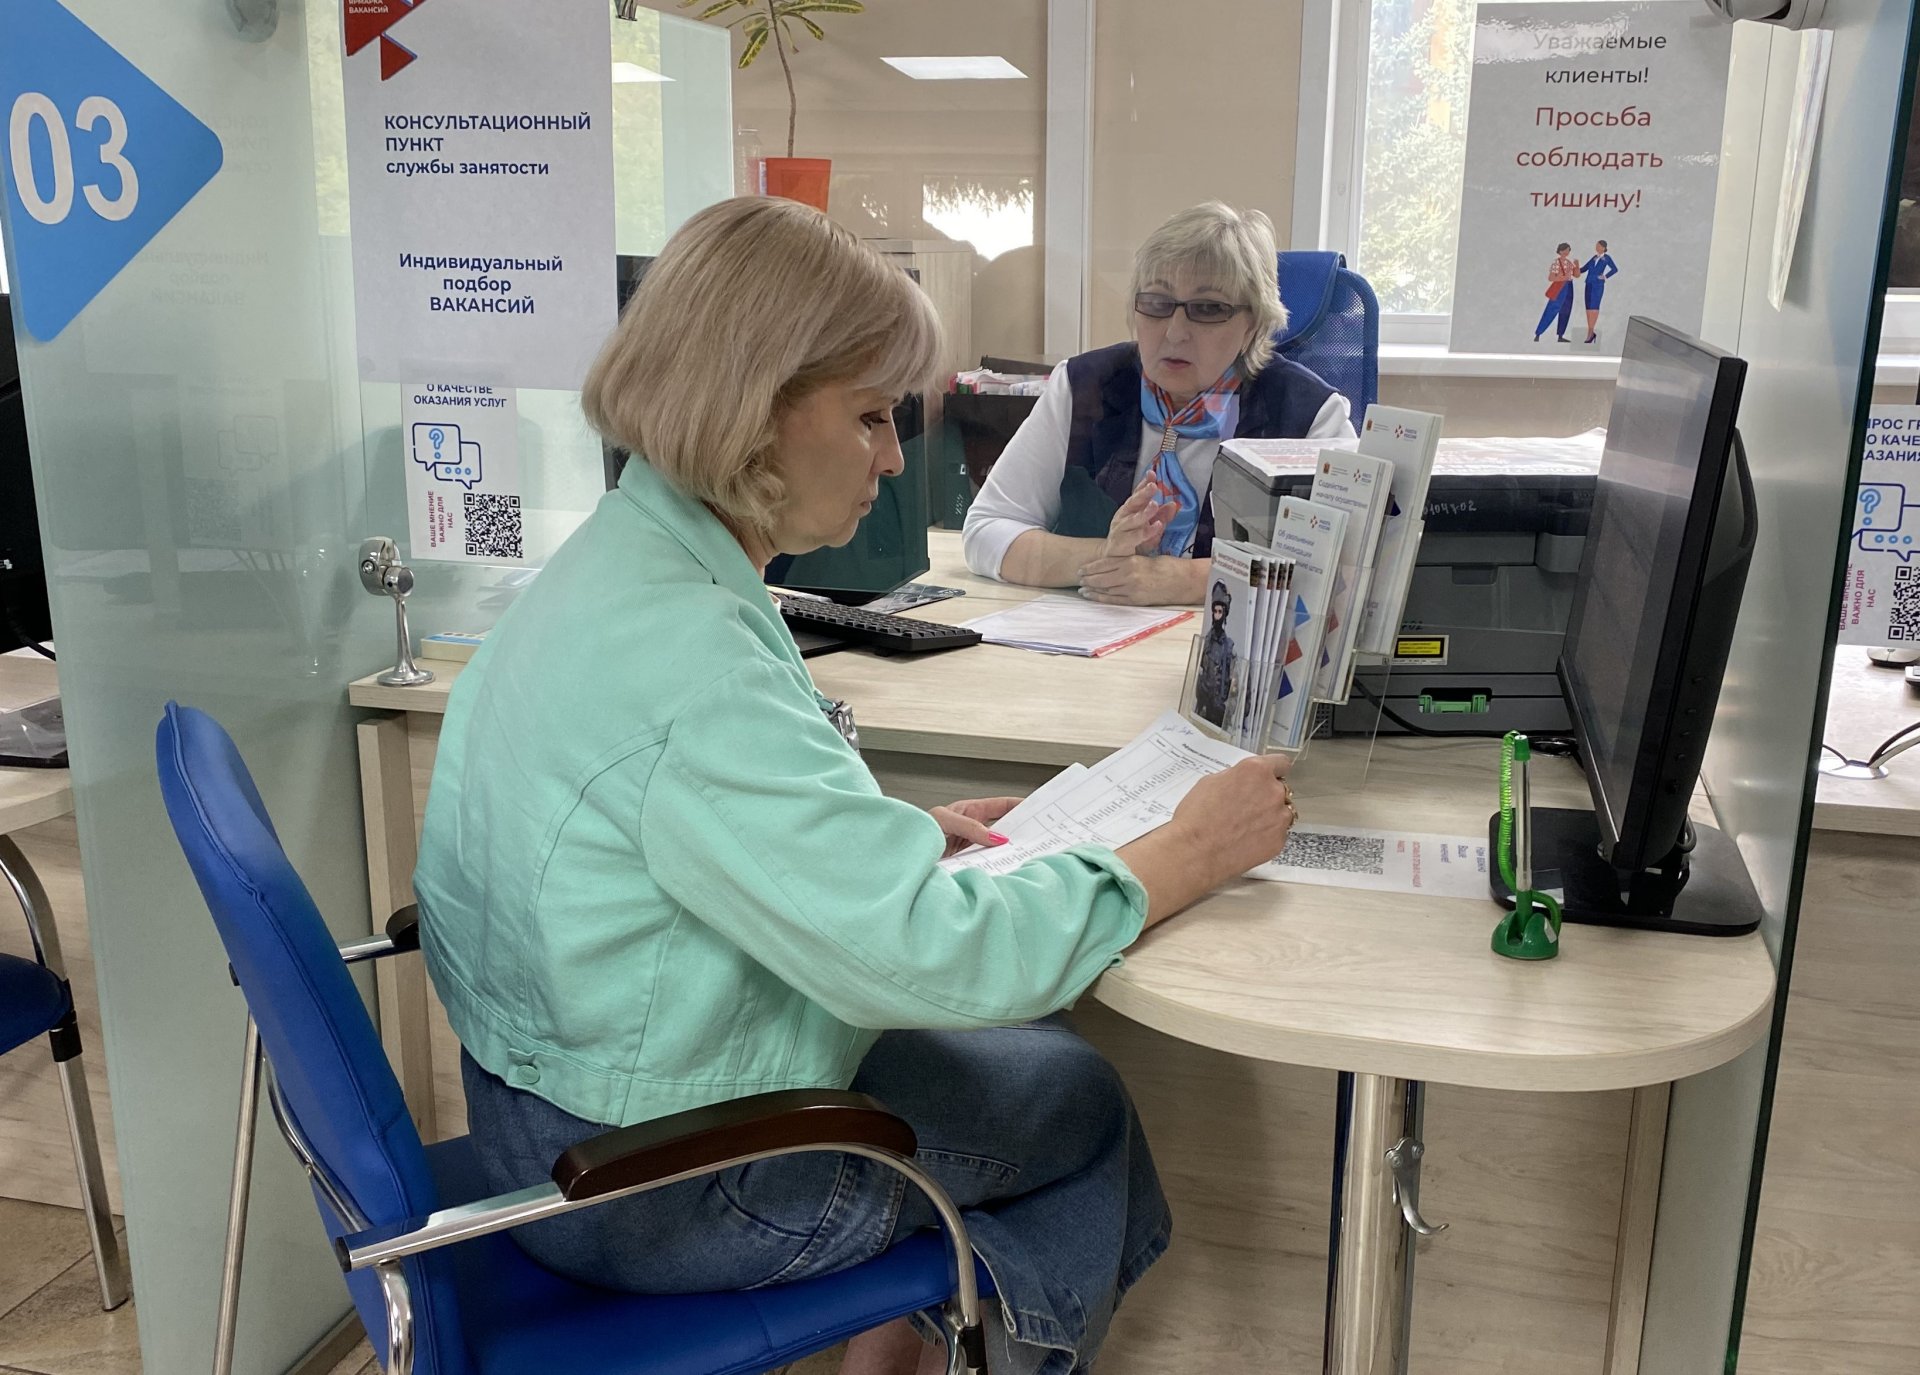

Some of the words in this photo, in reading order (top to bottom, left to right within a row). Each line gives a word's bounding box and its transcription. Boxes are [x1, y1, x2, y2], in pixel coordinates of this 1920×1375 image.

[349, 6, 389, 14] ВАКАНСИЙ
[1533, 34, 1667, 50] Уважаемые
[1545, 67, 1649, 84] клиенты!
[384, 112, 591, 132] КОНСУЛЬТАЦИОННЫЙ
[1535, 105, 1652, 131] Просьба
[385, 137, 444, 152] ПУНКТ
[9, 91, 139, 225] 03
[386, 158, 454, 177] службы
[459, 162, 550, 175] занятости
[1516, 146, 1664, 170] соблюдать
[1530, 189, 1642, 213] тишину!
[399, 253, 563, 273] Индивидуальный
[443, 275, 512, 295] подбор
[430, 296, 535, 314] ВАКАНСИЙ
[413, 395, 471, 407] ОКАЗАНИЯ
[474, 397, 507, 408] УСЛУГ
[1866, 433, 1877, 445] О
[1855, 570, 1865, 589] ДЛЯ
[1866, 588, 1876, 607] НАС
[1851, 591, 1862, 625] ВАЖНО
